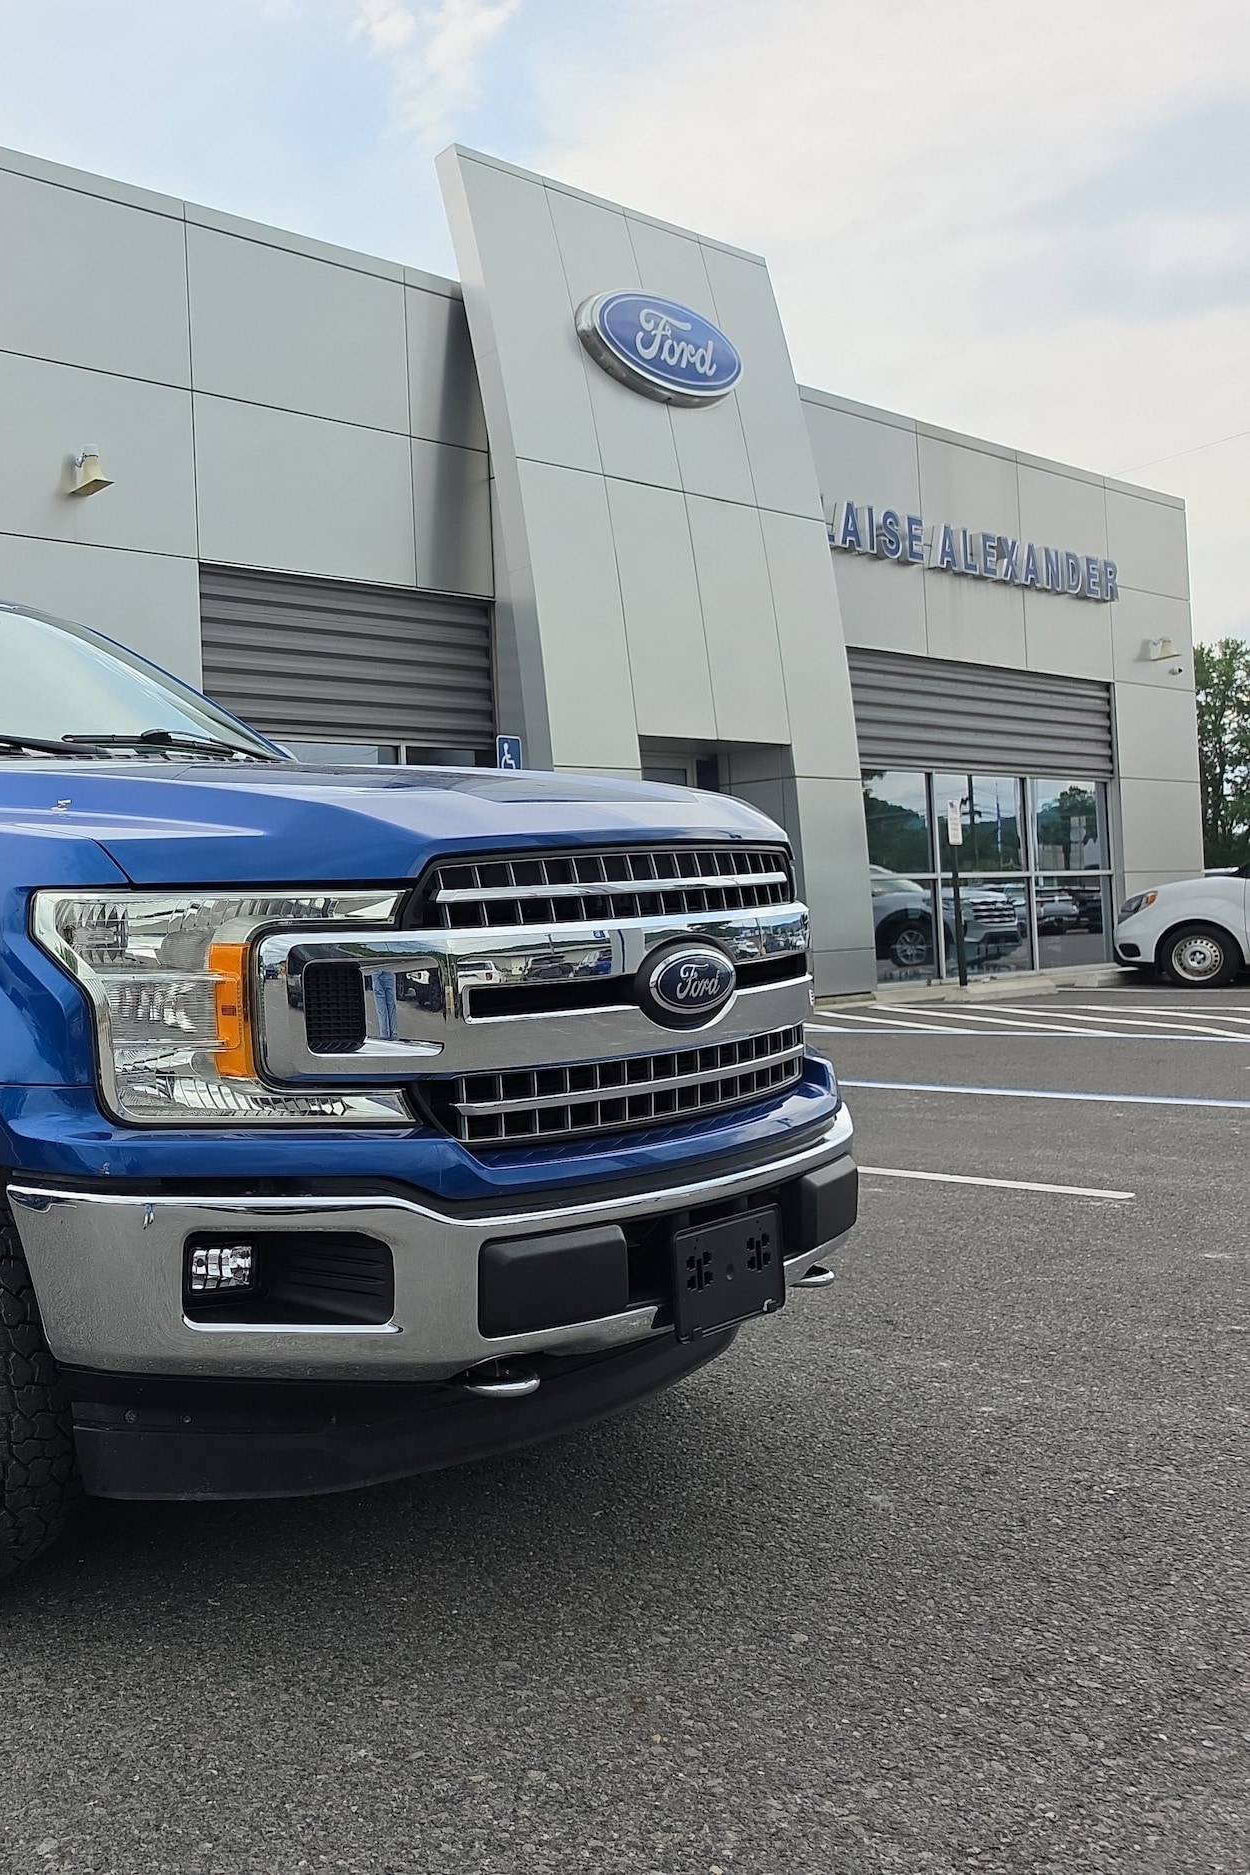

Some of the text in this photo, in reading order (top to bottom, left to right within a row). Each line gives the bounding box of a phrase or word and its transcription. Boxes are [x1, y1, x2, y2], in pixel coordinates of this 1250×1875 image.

[636, 308, 717, 376] Ford
[938, 522, 1120, 602] ALEXANDER
[676, 963, 721, 1000] Ford
